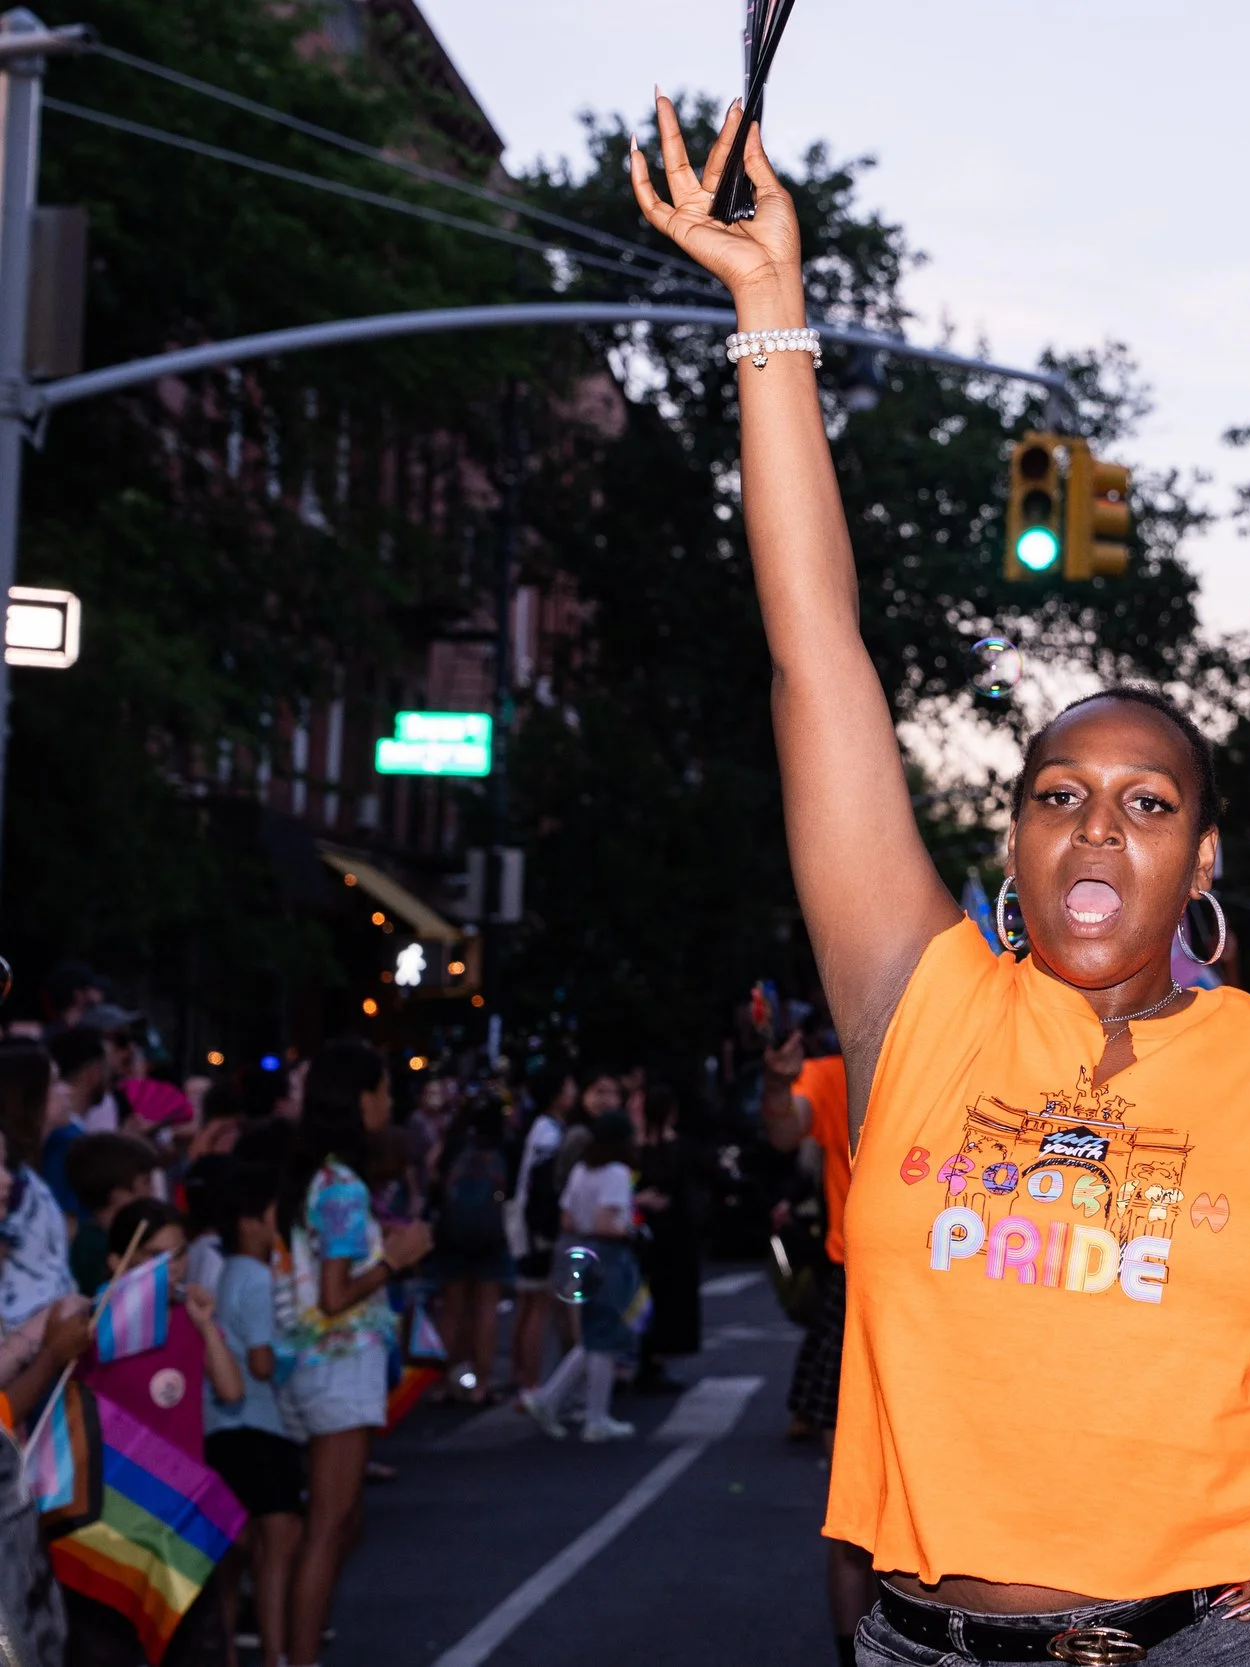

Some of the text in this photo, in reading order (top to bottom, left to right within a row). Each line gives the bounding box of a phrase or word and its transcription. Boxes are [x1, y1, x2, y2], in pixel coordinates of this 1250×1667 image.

[899, 1145, 1231, 1234] BROOKLYN
[1039, 1143, 1104, 1160] youth
[930, 1205, 1172, 1304] PRIDE
